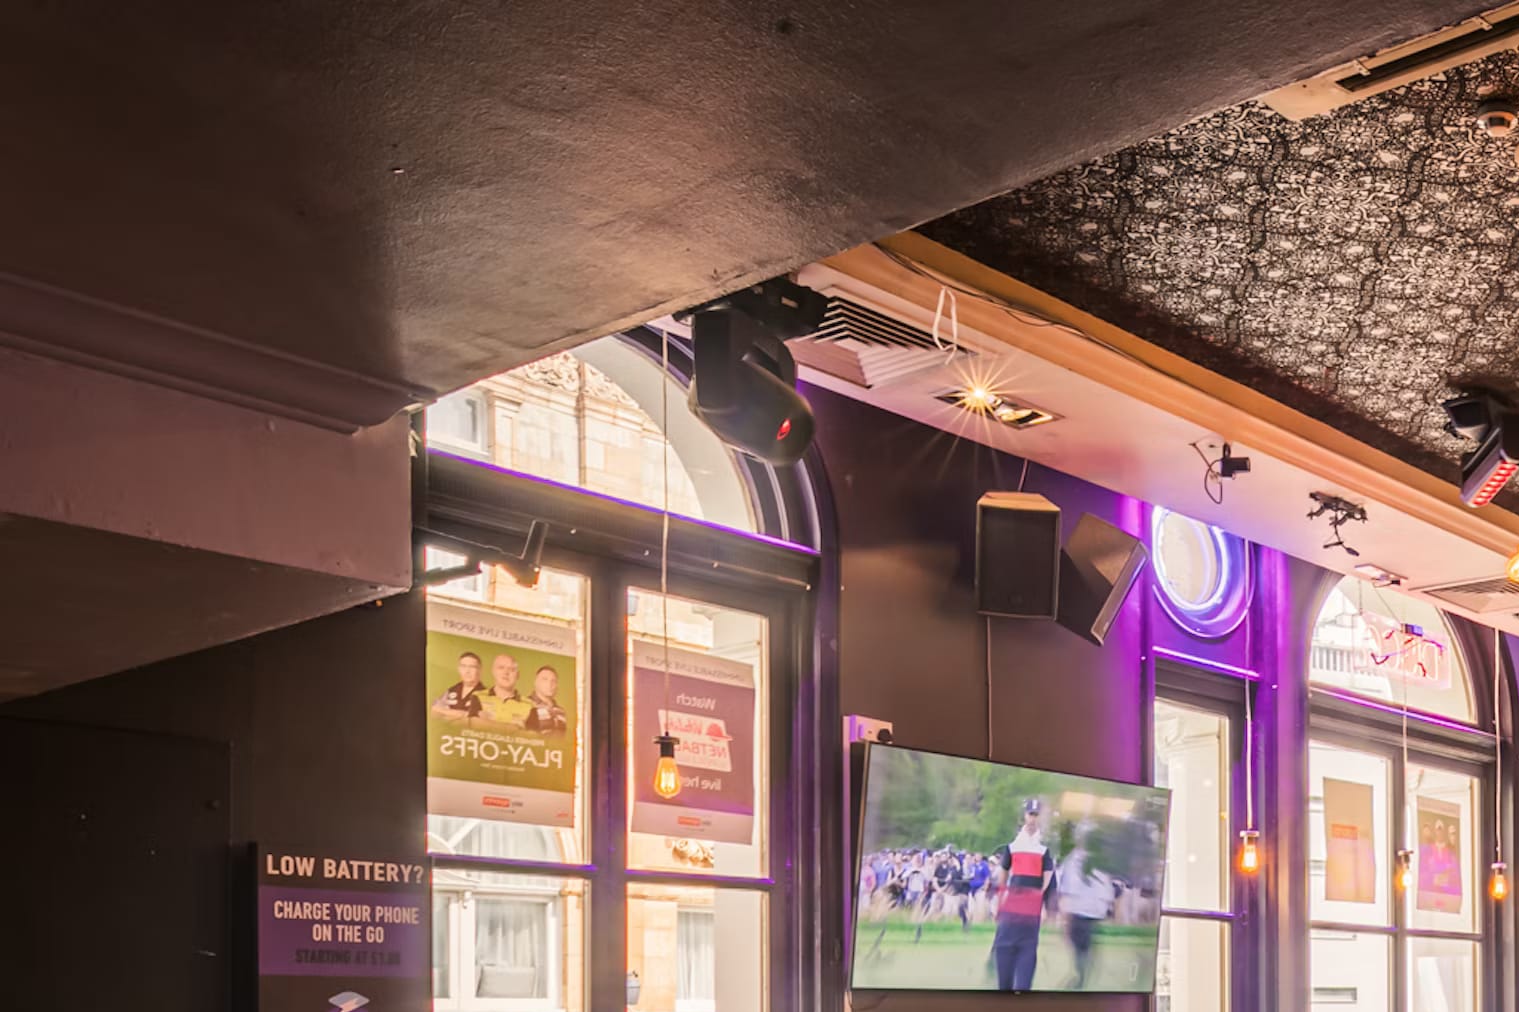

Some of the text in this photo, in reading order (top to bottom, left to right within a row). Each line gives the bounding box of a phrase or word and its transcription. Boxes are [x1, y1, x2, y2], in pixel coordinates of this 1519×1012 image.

[266, 853, 424, 884] LOW BATTERY?
[273, 900, 419, 924] CHARGE YOUR PHONE
[312, 924, 384, 944] ON THE GO
